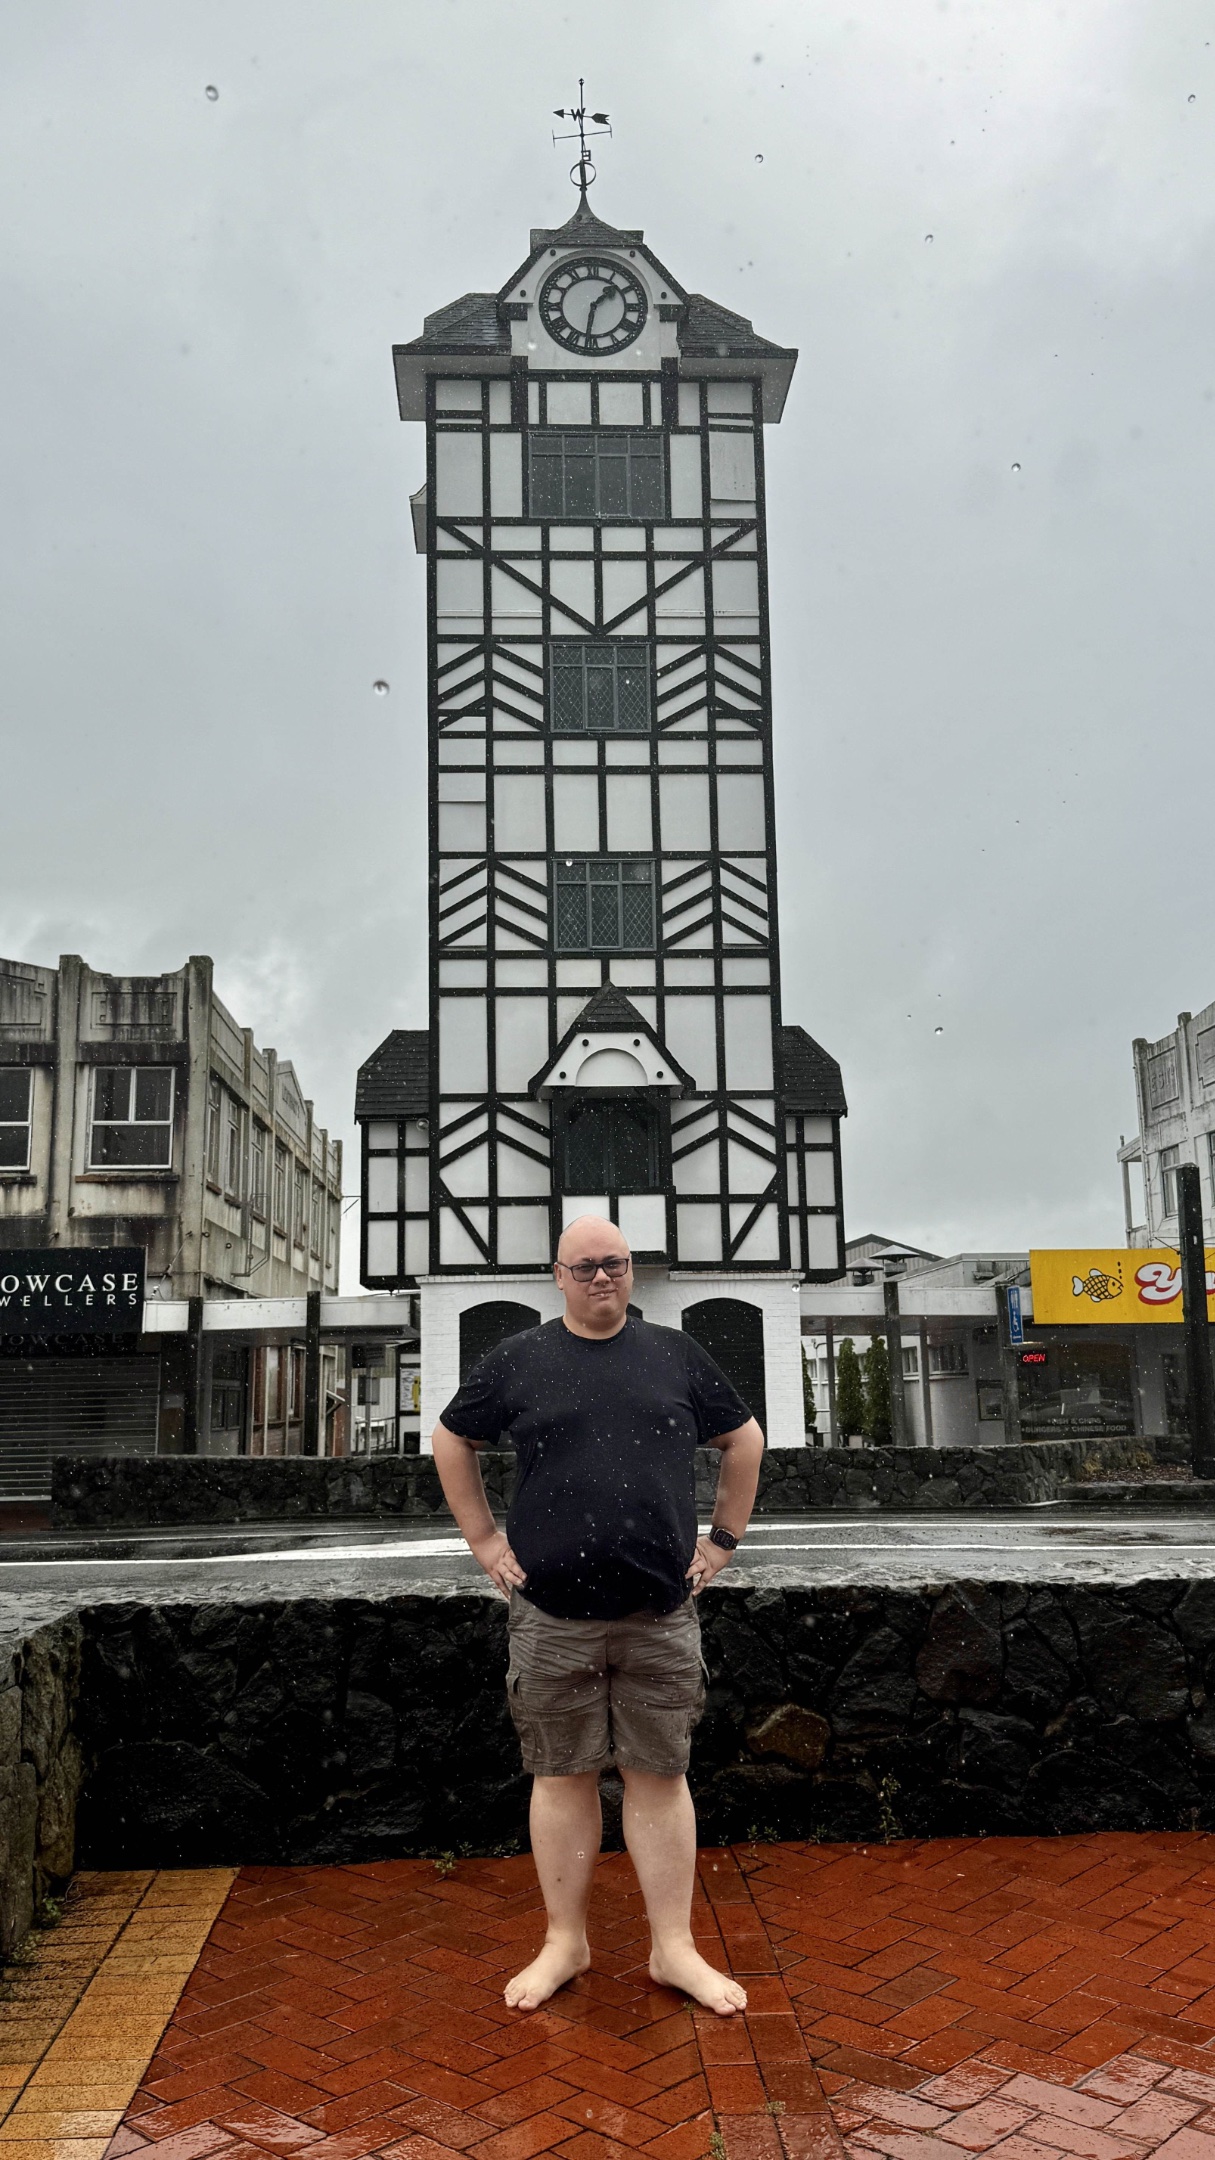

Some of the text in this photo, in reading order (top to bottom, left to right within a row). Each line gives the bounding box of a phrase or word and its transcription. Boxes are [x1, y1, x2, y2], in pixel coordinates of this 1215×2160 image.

[571, 108, 586, 121] W
[0, 1273, 139, 1294] OWCASE
[0, 1293, 138, 1307] WELLERS
[0, 1334, 124, 1345] OWCASE
[1022, 1353, 1046, 1364] OPEN
[1071, 1425, 1105, 1433] CHINESE
[1105, 1424, 1127, 1432] FOOD
